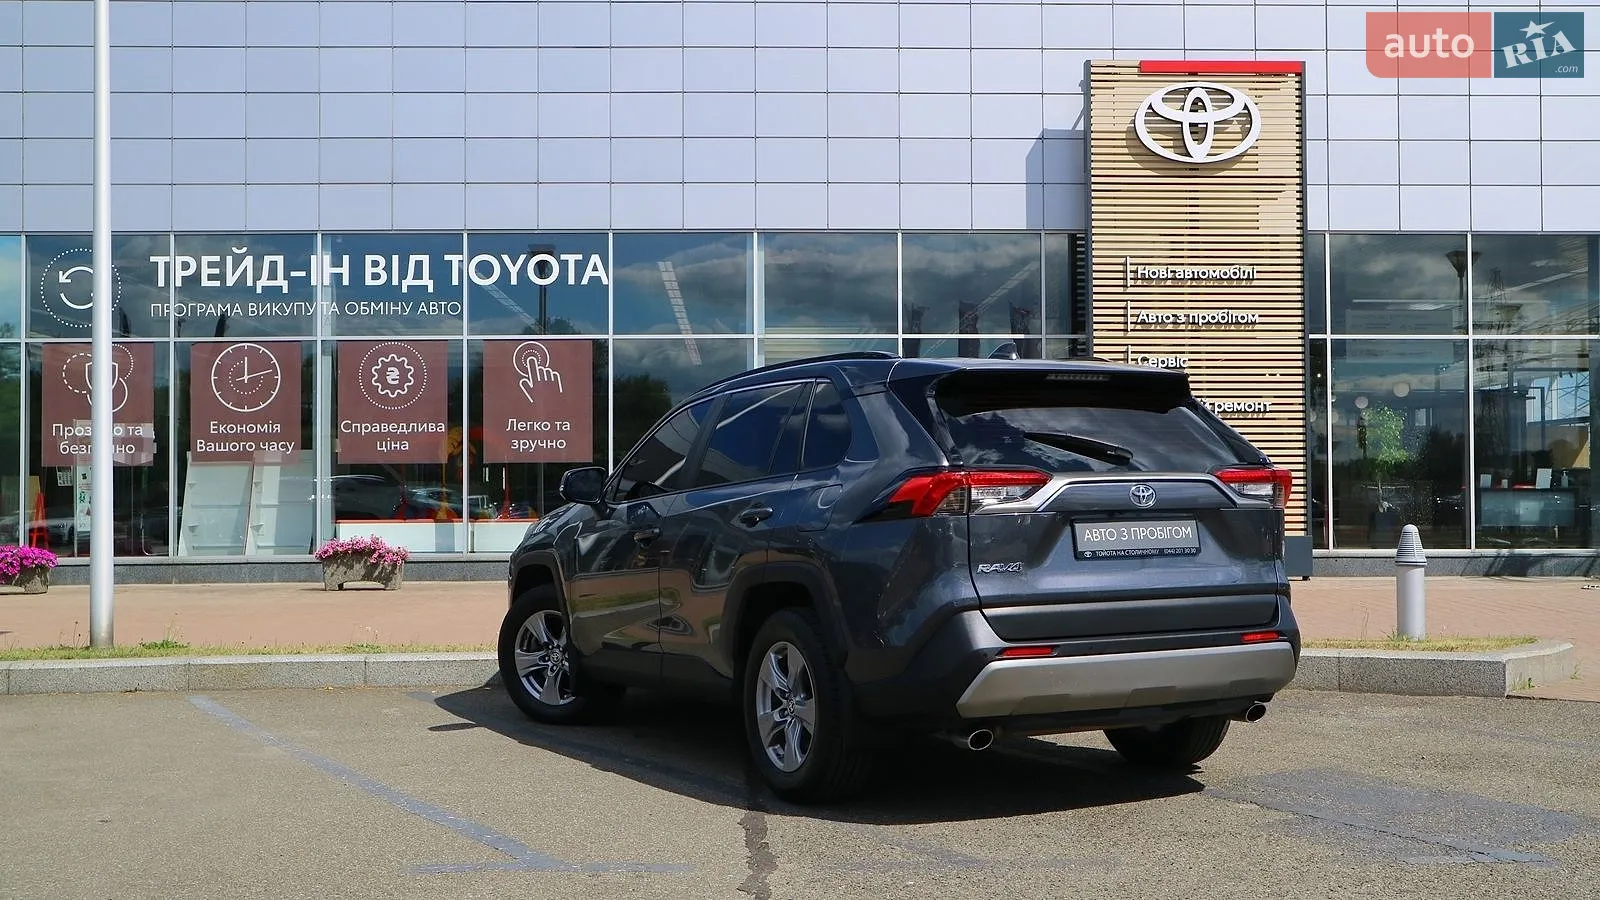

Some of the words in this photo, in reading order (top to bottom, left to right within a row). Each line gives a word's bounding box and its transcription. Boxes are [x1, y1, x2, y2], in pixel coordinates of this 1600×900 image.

[150, 246, 350, 294] ТРЕЙД-ІН
[364, 254, 434, 293] ВІД
[444, 253, 610, 286] TOYOTA
[1137, 266, 1173, 279] Нові
[1176, 264, 1257, 280] автомобілі
[151, 303, 243, 317] ПРОГРАМА
[249, 302, 316, 318] ВИКУПУ
[320, 302, 340, 316] ТА
[345, 301, 411, 317] ОБМІНУ
[416, 301, 462, 316] АВТО
[1137, 310, 1173, 324] Авто
[1177, 314, 1185, 323] з
[1189, 308, 1259, 326] пробігом
[1137, 354, 1189, 368] Сервіс
[1215, 401, 1272, 415] ремонт
[53, 424, 123, 439] Прозо
[127, 426, 143, 436] та
[210, 420, 281, 434] Економія
[340, 420, 445, 433] Справедлива
[506, 419, 551, 433] Легко
[555, 420, 571, 431] та
[60, 441, 136, 454] безно
[197, 440, 256, 453] Вашого
[260, 441, 296, 454] часу
[377, 438, 409, 451] ціна
[511, 438, 567, 452] зручно
[1084, 528, 1117, 542] АВТО
[1131, 526, 1192, 540] ПРОБІГОМ
[1096, 549, 1116, 557] ТОЙОТА
[976, 561, 1022, 573] RAV4
